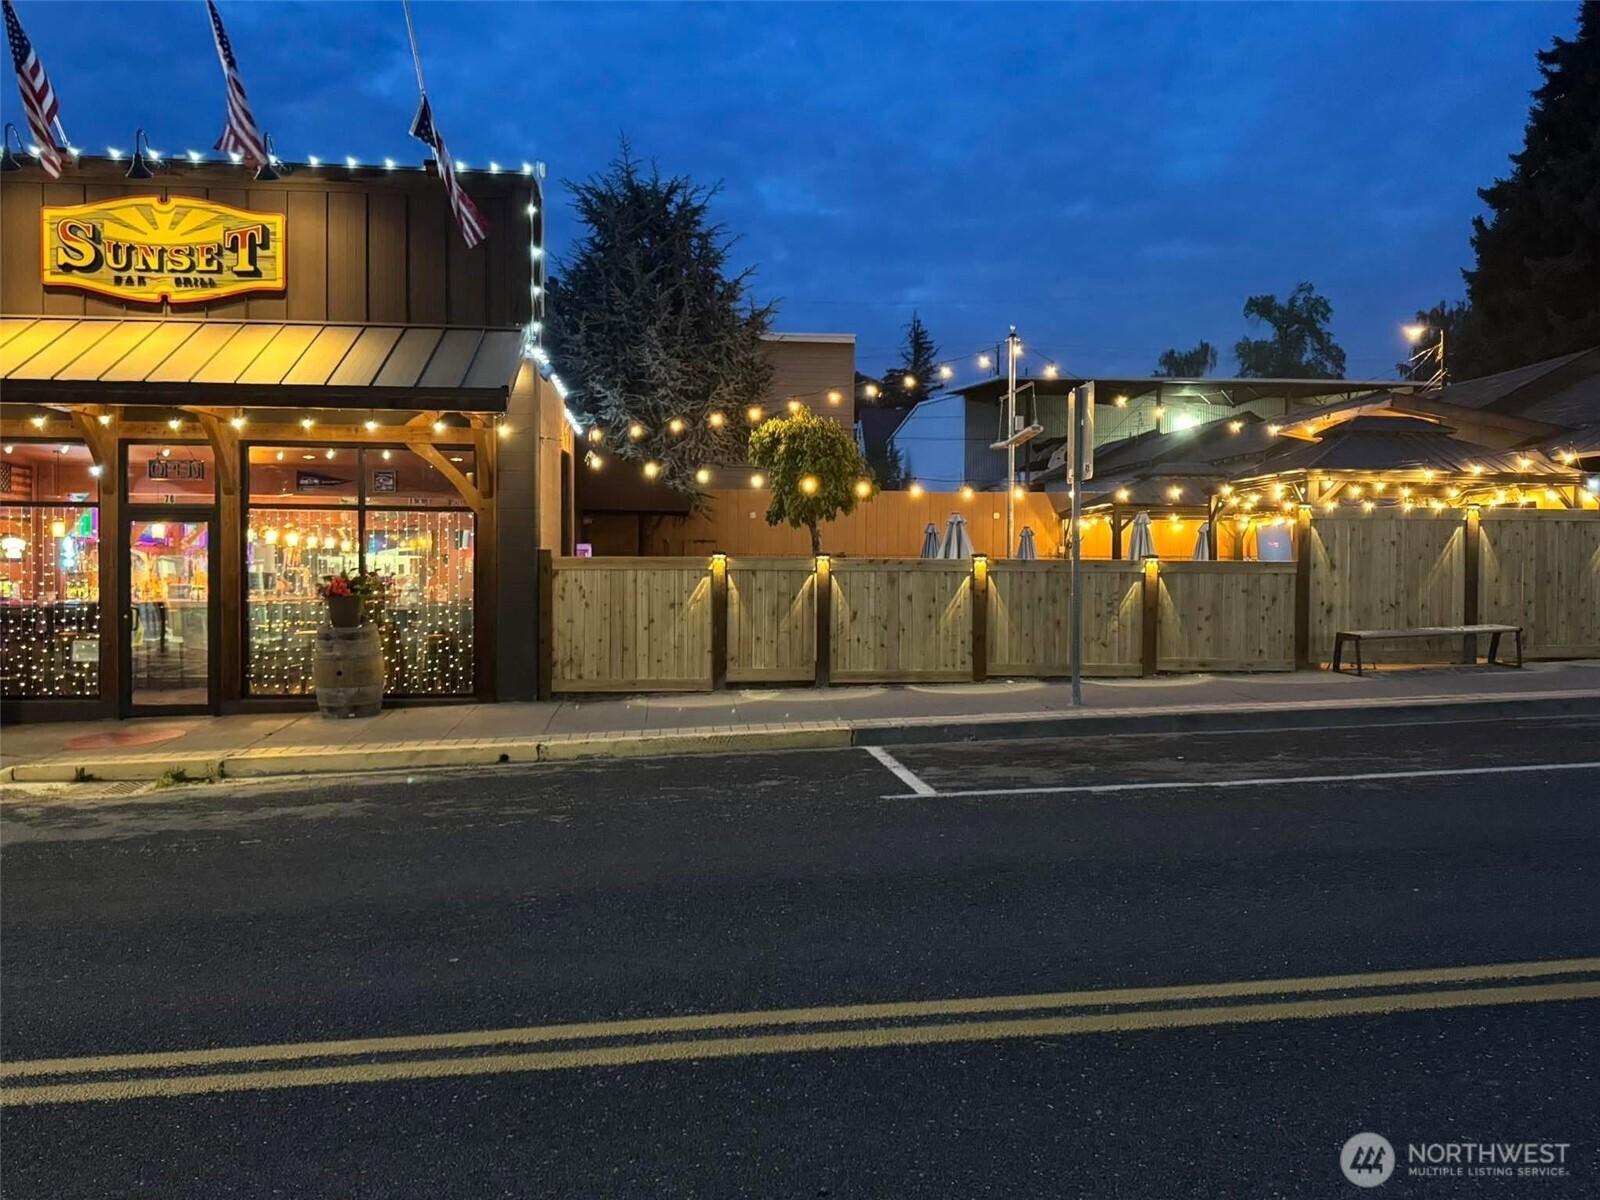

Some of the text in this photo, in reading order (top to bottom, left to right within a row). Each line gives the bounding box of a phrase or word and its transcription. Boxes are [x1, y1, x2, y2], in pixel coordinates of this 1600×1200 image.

[57, 218, 270, 278] SUNSET
[114, 275, 217, 288] BAR GRILL
